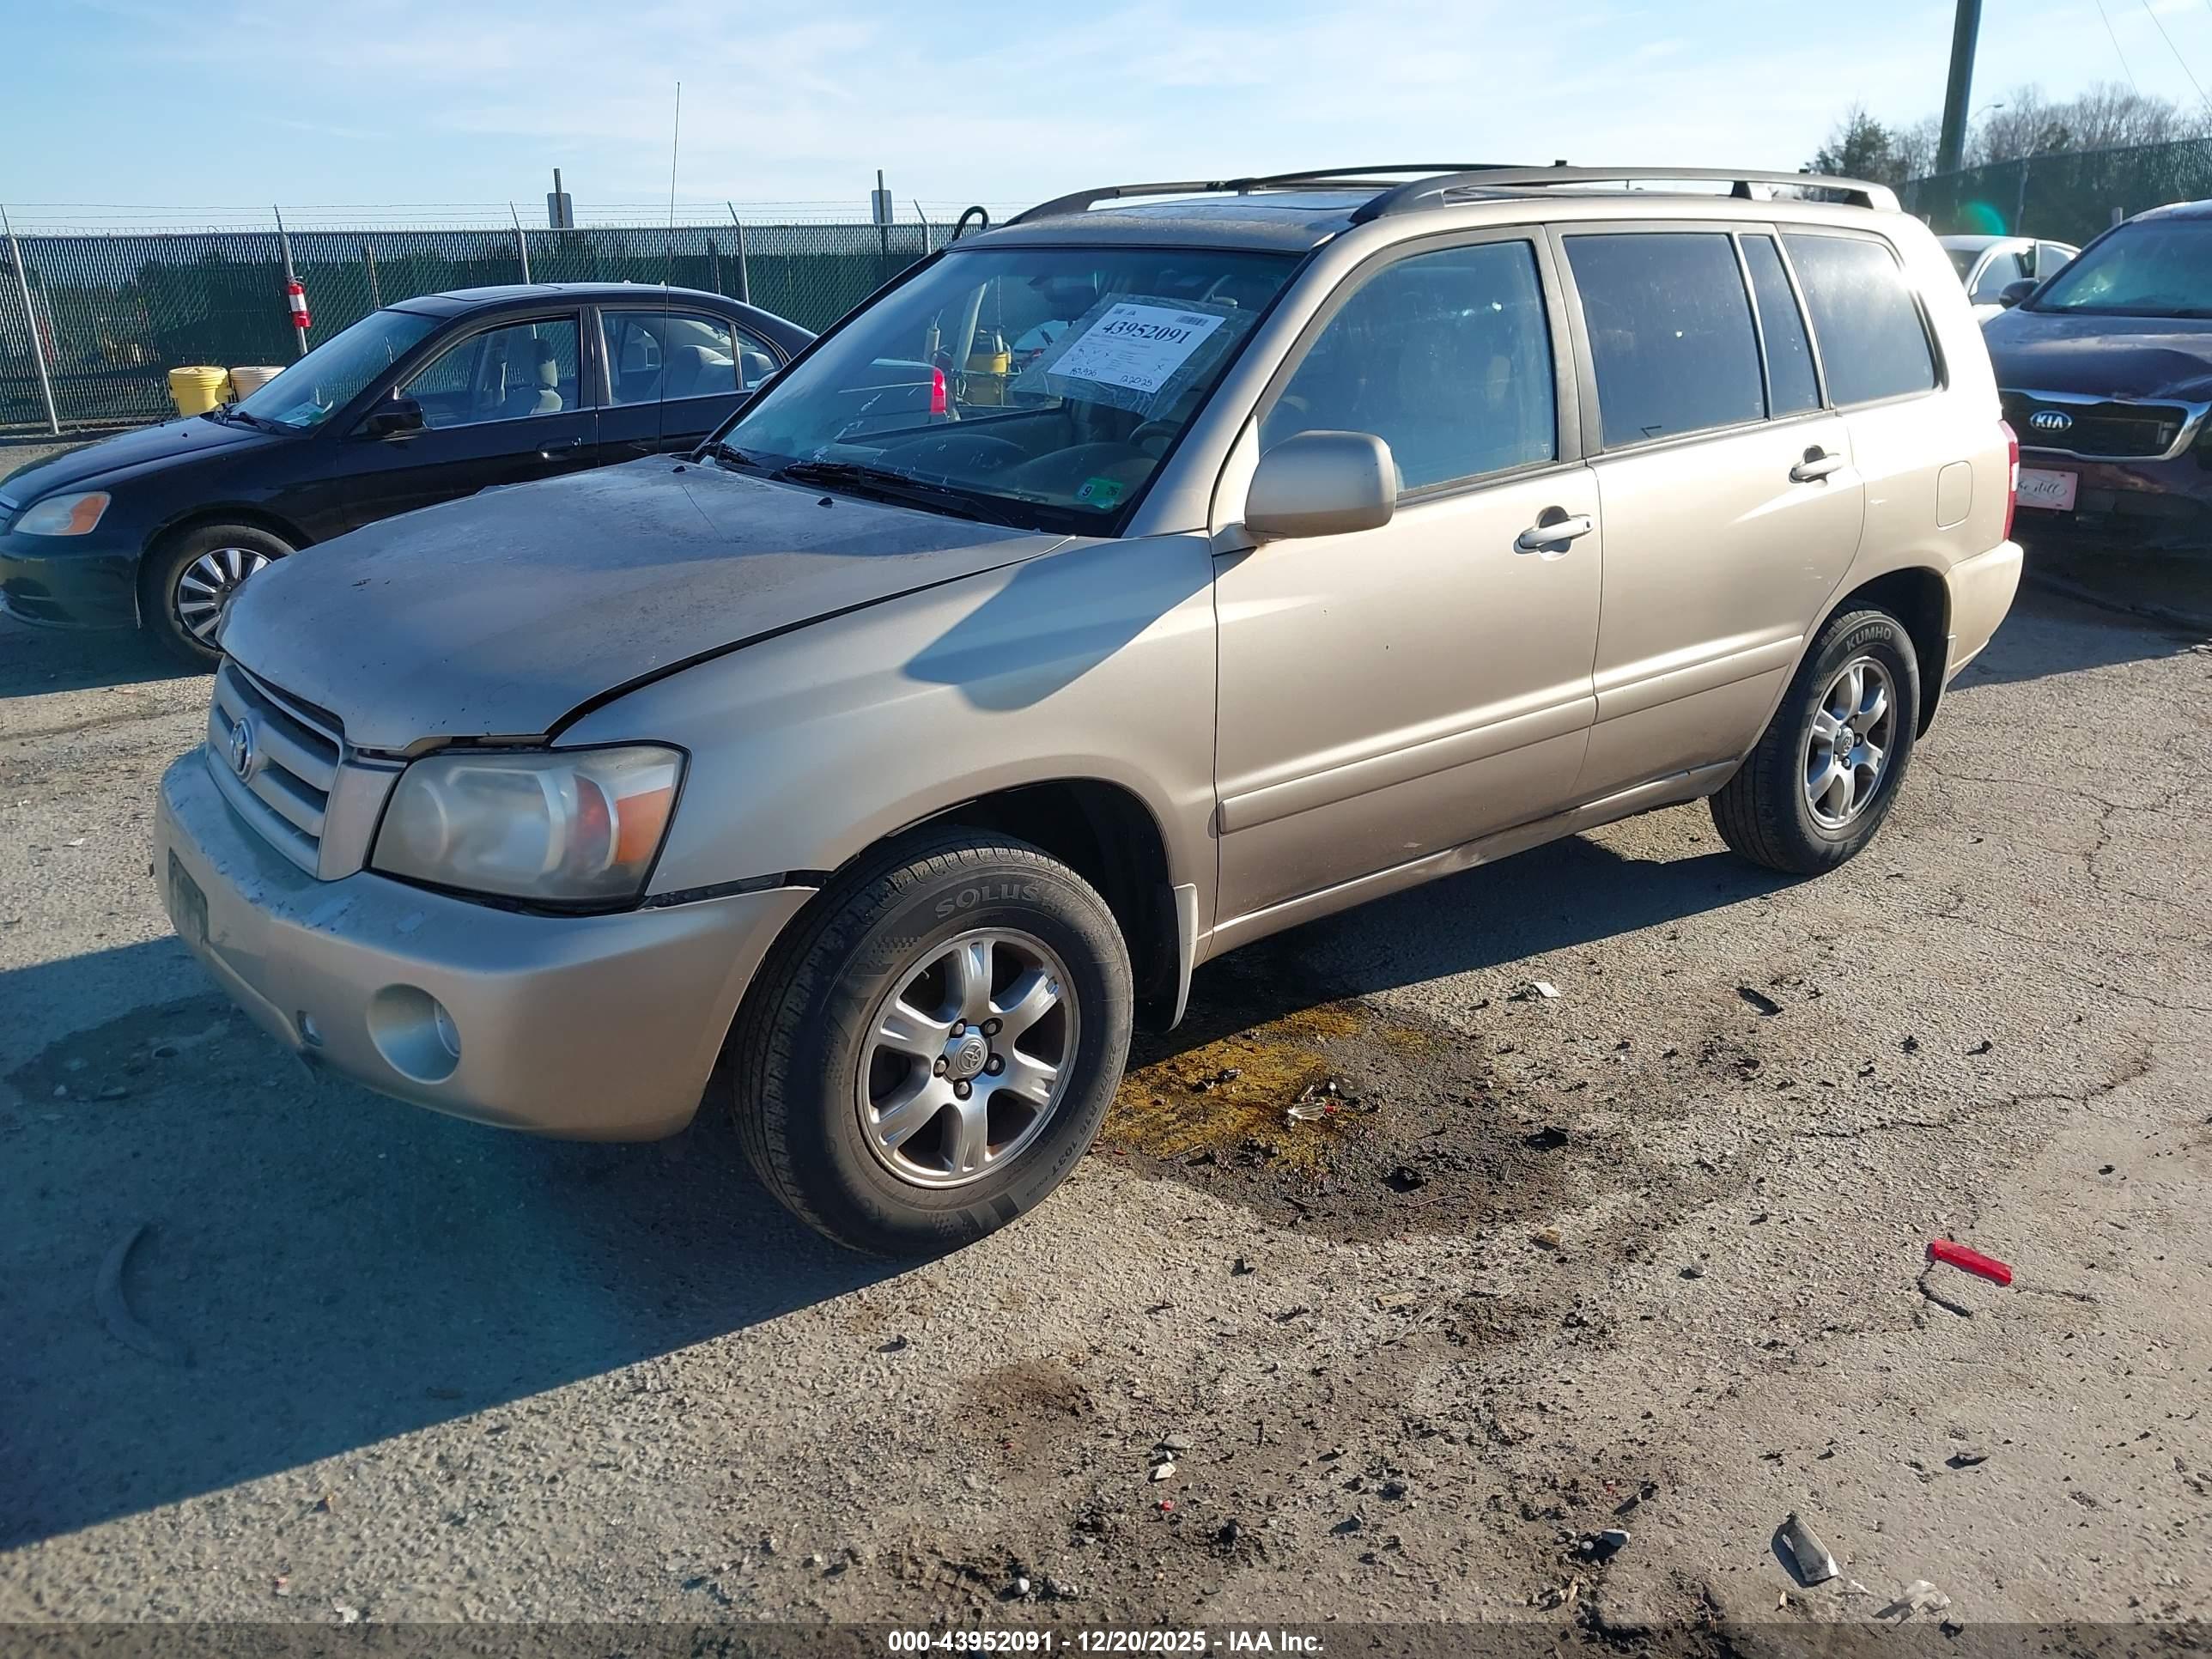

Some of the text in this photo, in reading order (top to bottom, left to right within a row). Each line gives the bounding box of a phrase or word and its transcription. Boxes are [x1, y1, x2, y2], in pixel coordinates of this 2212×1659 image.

[1103, 319, 1192, 345] 43952091
[2036, 415, 2063, 428] KIA
[1082, 485, 1093, 496] 9
[1846, 627, 1892, 652] KUMHO
[934, 884, 1039, 919] SOLUS
[1051, 1139, 1078, 1176] 103T
